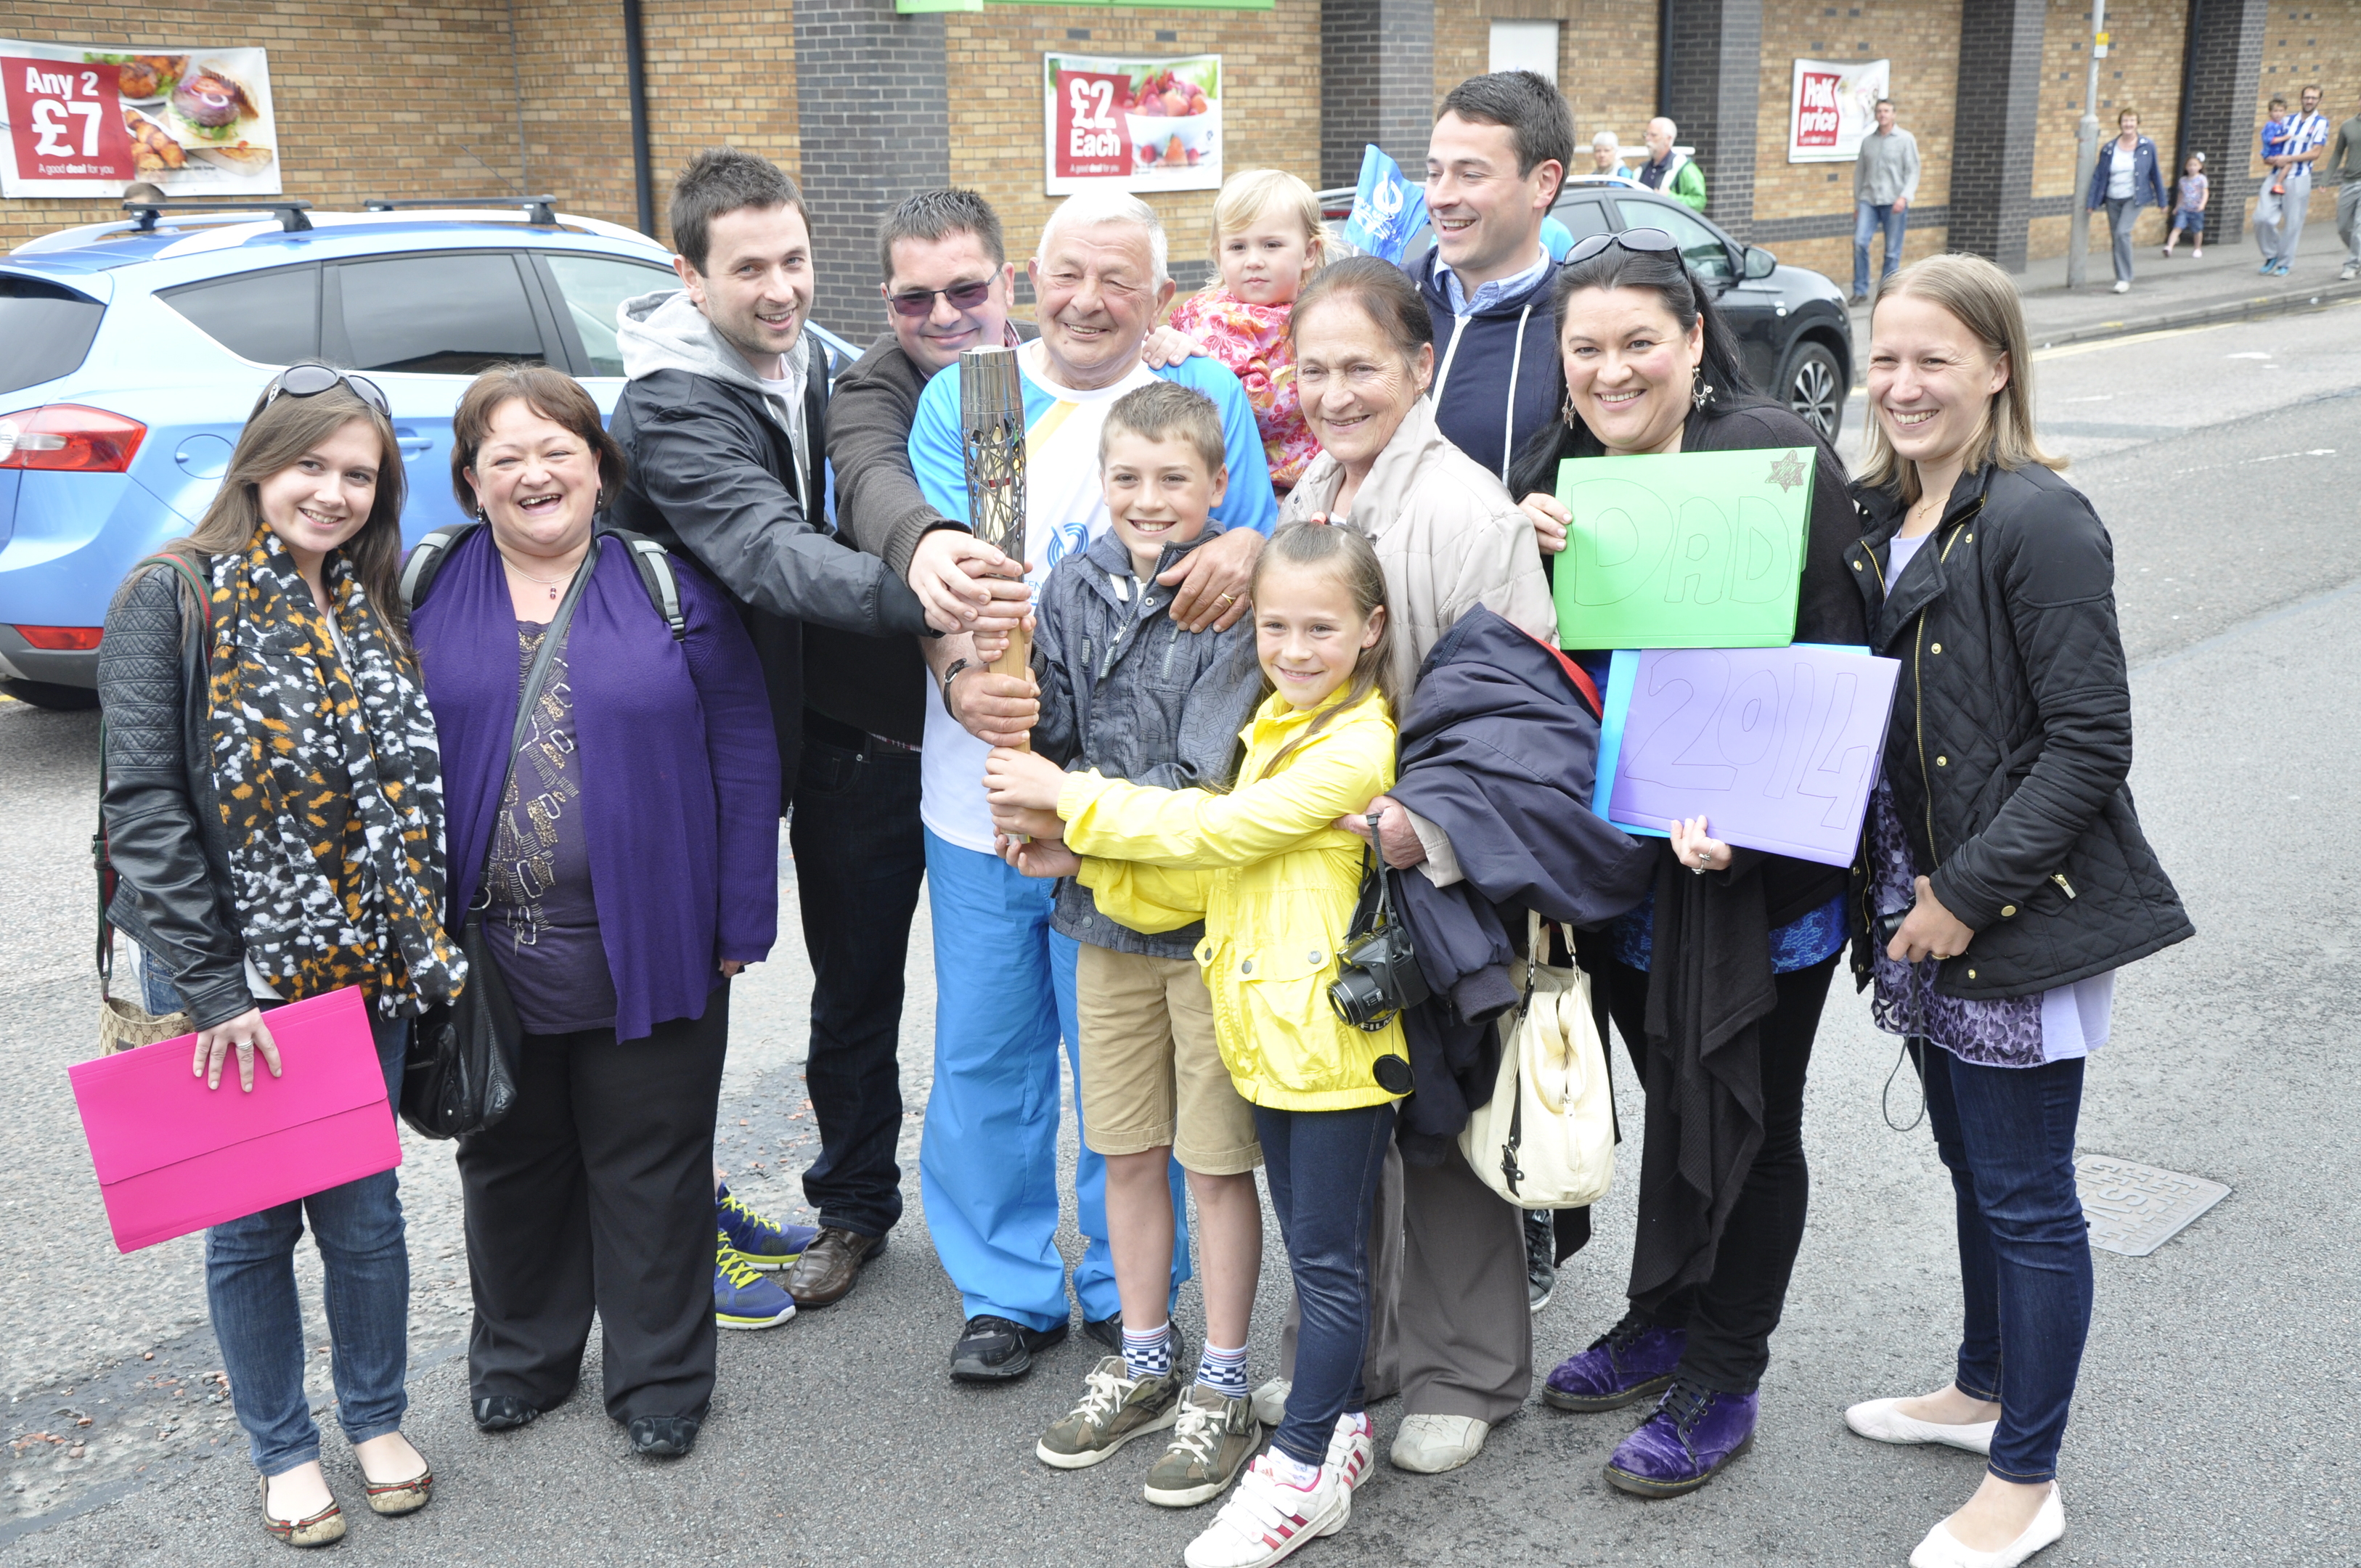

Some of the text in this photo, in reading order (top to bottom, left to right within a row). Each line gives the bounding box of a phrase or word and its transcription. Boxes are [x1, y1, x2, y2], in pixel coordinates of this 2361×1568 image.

[25, 67, 99, 100] Any 2
[1803, 76, 1835, 107] Half
[1069, 78, 1117, 129] £2
[31, 99, 103, 158] £7
[1800, 108, 1838, 136] price
[1069, 128, 1120, 157] Each
[38, 163, 115, 176] A good deal for you
[1571, 478, 1792, 606] DAD
[1623, 648, 1869, 830] 2014
